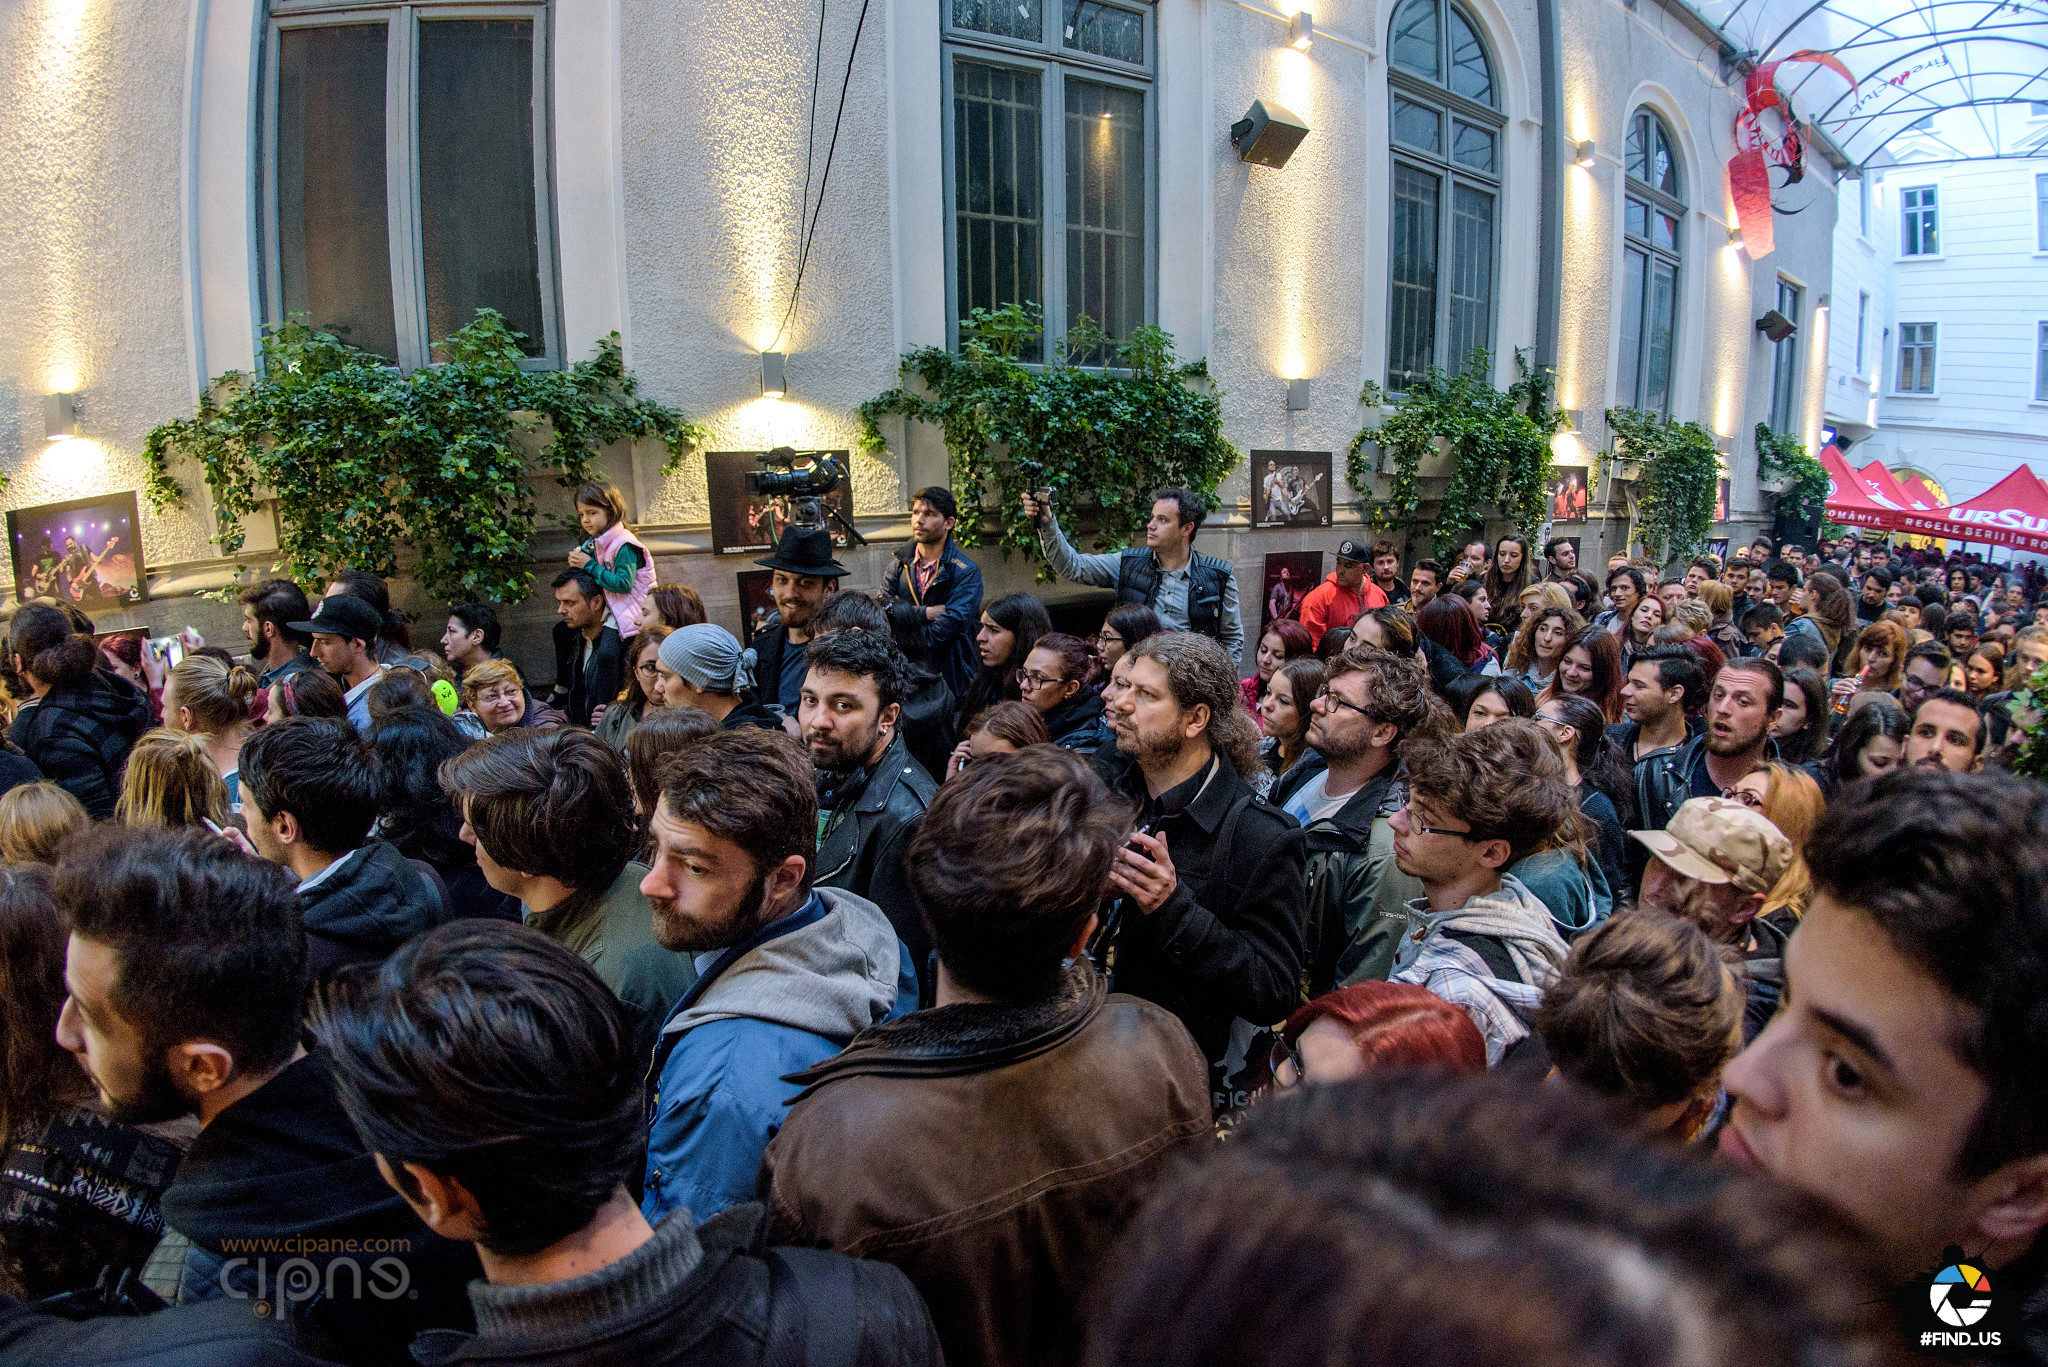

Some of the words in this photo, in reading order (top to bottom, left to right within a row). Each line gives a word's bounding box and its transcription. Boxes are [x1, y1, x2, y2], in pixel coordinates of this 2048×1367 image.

[1905, 517, 1960, 534] REGELE
[1964, 527, 2007, 542] BERII
[1947, 507, 2048, 533] URSU
